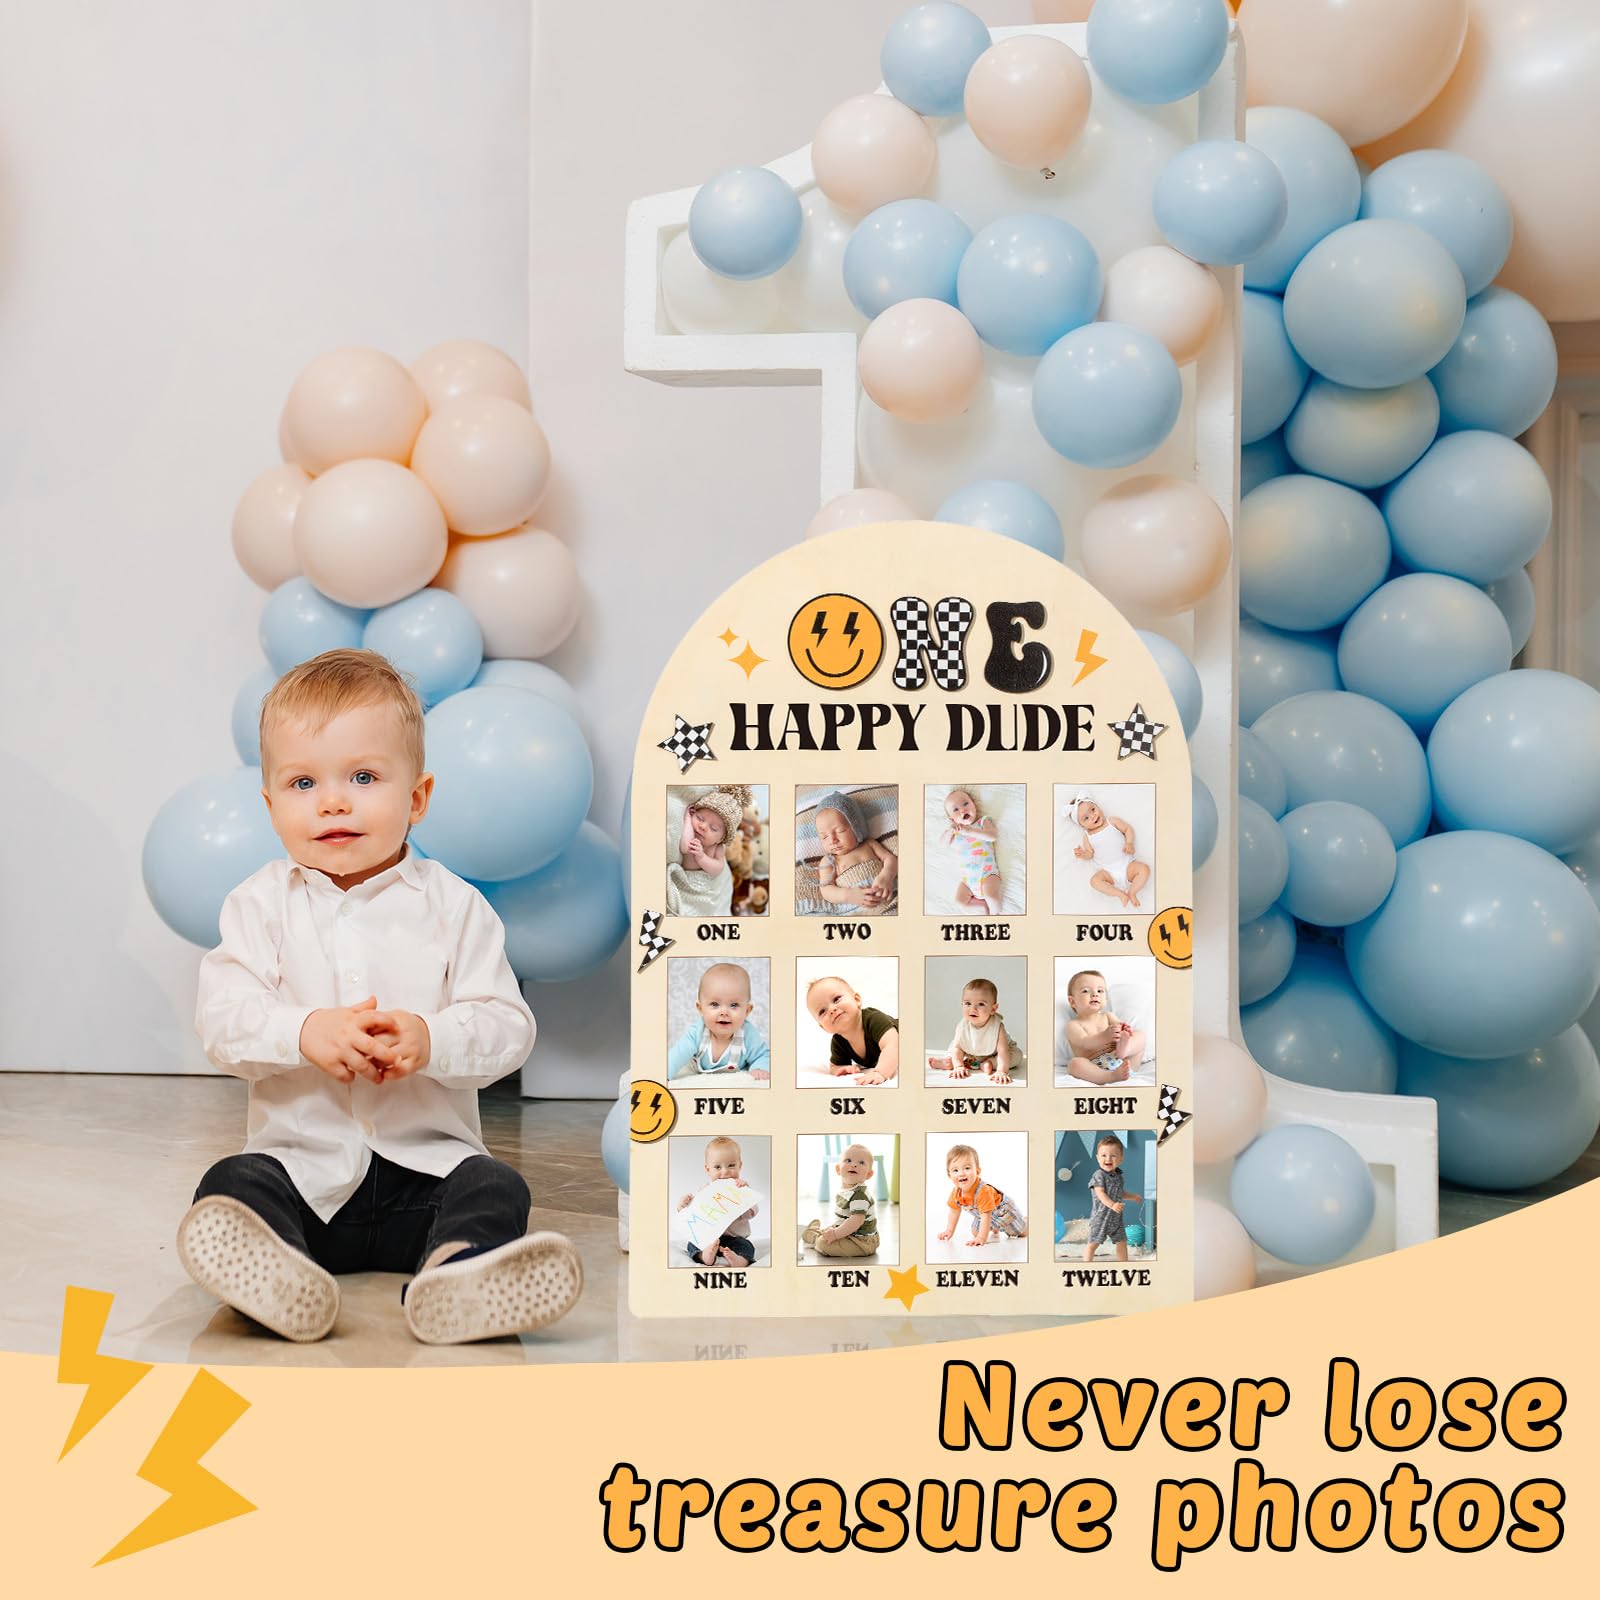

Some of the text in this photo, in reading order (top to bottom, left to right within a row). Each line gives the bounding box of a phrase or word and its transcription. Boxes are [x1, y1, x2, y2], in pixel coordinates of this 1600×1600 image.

[729, 702, 1096, 752] HAPPY DUDE
[696, 923, 741, 942] ONE
[823, 922, 872, 941] TWO
[940, 923, 1011, 942] THREE
[1076, 923, 1134, 942] FOUR
[693, 1097, 745, 1116] FIVE
[830, 1097, 866, 1116] SIX
[941, 1097, 1012, 1115] SEVEN
[1073, 1096, 1138, 1115] EIGHT
[693, 1271, 748, 1290] NINE
[827, 1270, 870, 1288] TEN
[935, 1269, 1020, 1288] ELEVEN
[1062, 1268, 1151, 1288] TWELVE
